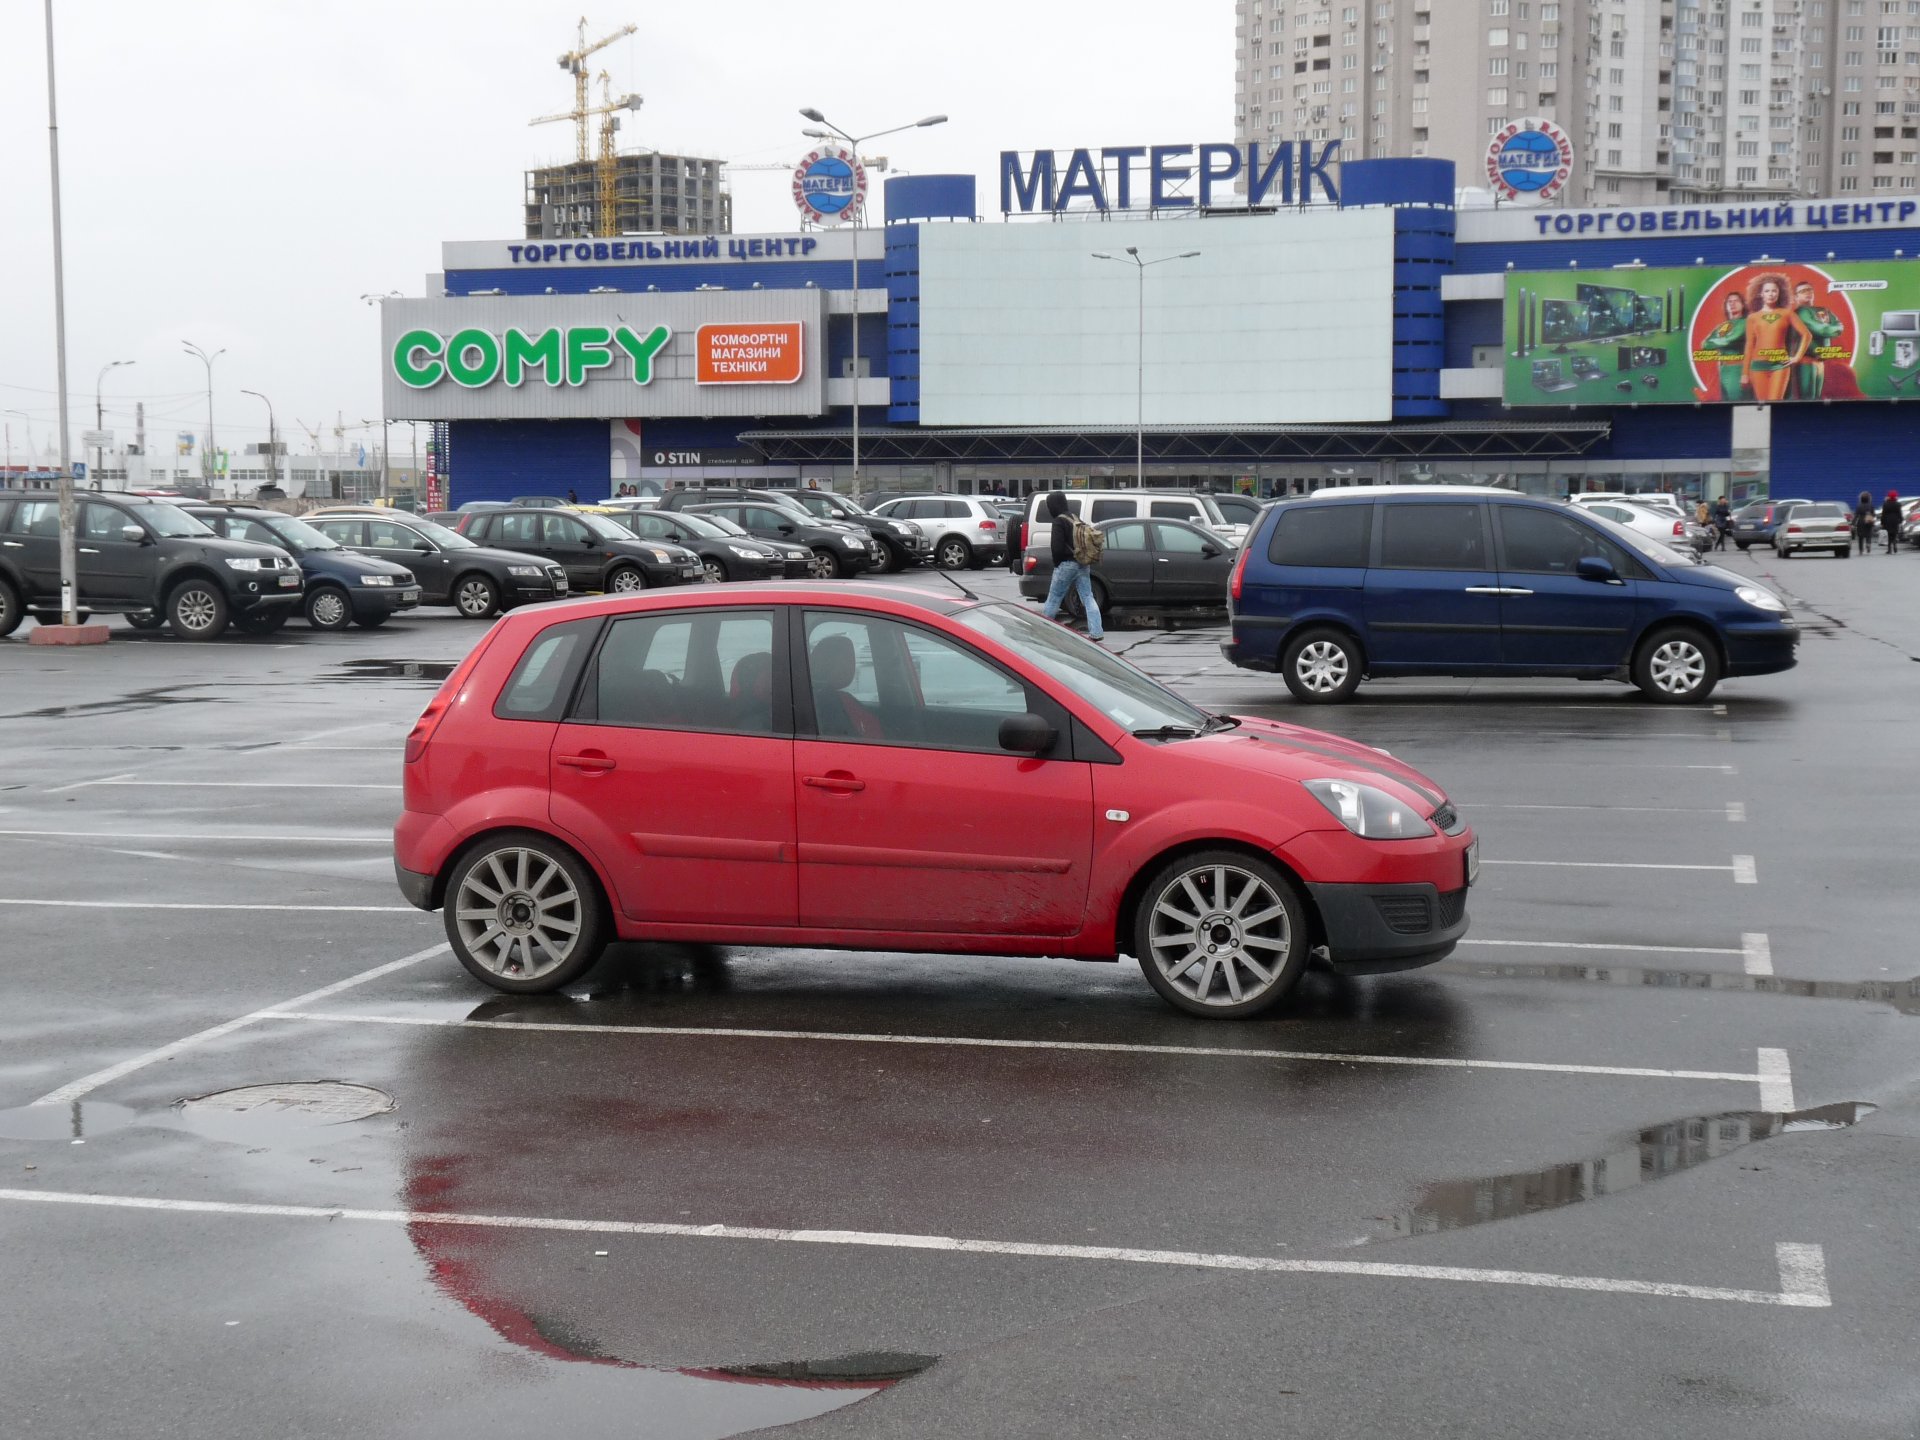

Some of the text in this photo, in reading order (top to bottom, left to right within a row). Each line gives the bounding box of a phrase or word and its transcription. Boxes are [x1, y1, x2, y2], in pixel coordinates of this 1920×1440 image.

[802, 177, 855, 189] МАТЕРИ
[1000, 139, 1341, 212] МАТЕРИК
[1534, 201, 1917, 234] ТОРГОВЕЛЬНИЙ ЦЕНТР
[507, 235, 817, 263] ТОРГОВЕЛЬНИЙ ЦЕНТР
[711, 333, 788, 346] КОМФОРТНІ
[392, 325, 672, 389] COMFY
[711, 347, 781, 359] МАГАЗИНИ
[712, 361, 767, 372] ТЕХНІКИ
